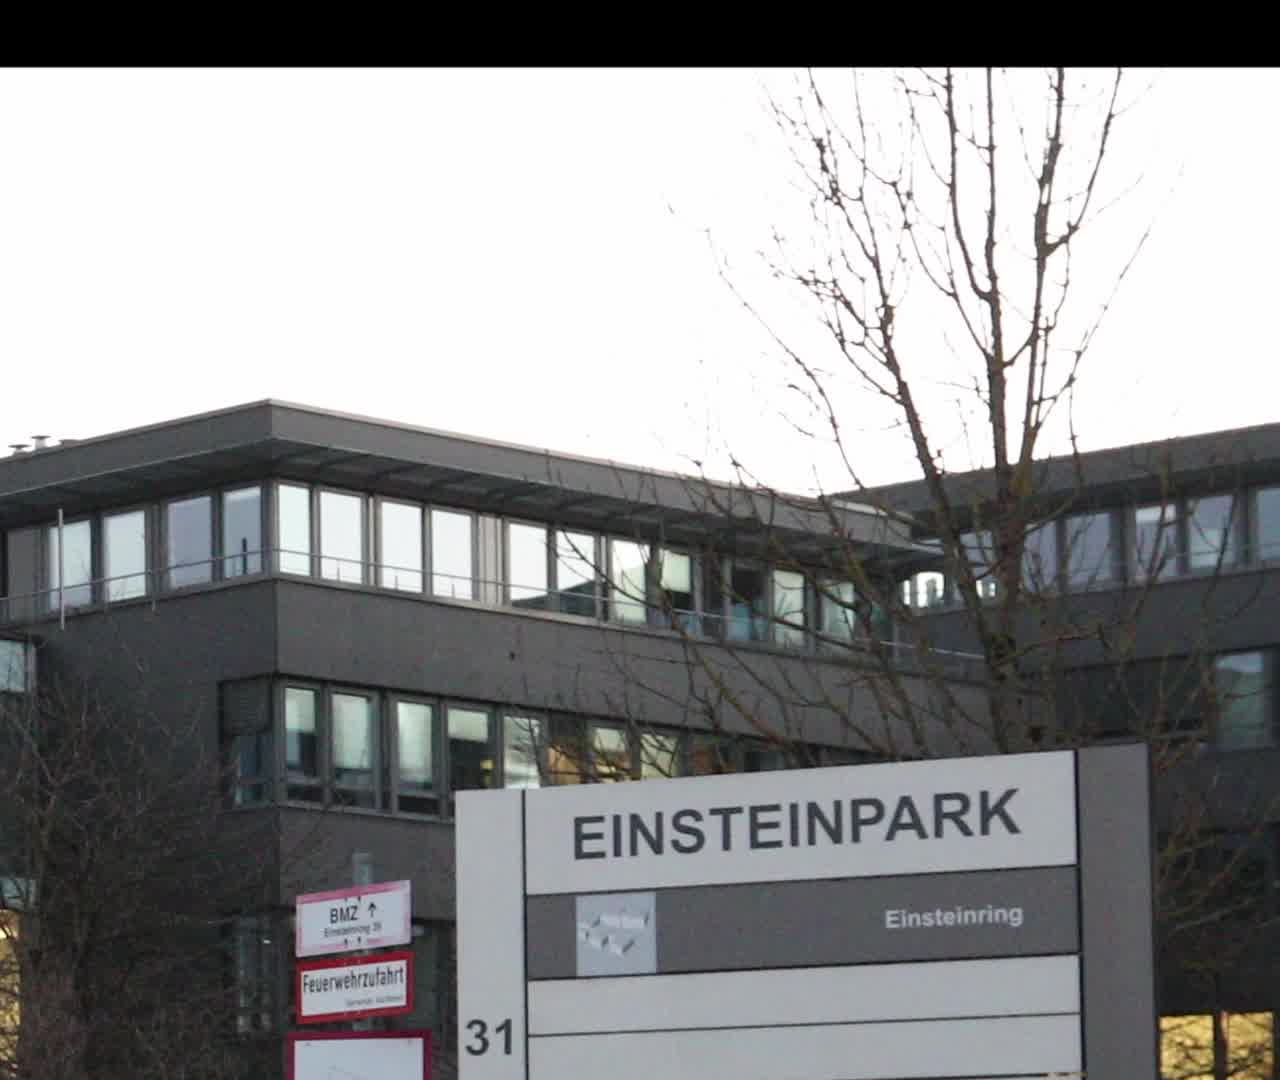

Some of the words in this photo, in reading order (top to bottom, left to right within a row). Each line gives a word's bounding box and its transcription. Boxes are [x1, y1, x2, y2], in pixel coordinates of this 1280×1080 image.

[572, 788, 1022, 861] EINSTEINPARK
[329, 904, 359, 924] BMZ
[884, 905, 1024, 930] Einsteinring
[302, 966, 404, 994] Feuerwehrzufahrt
[465, 1019, 513, 1056] 31
